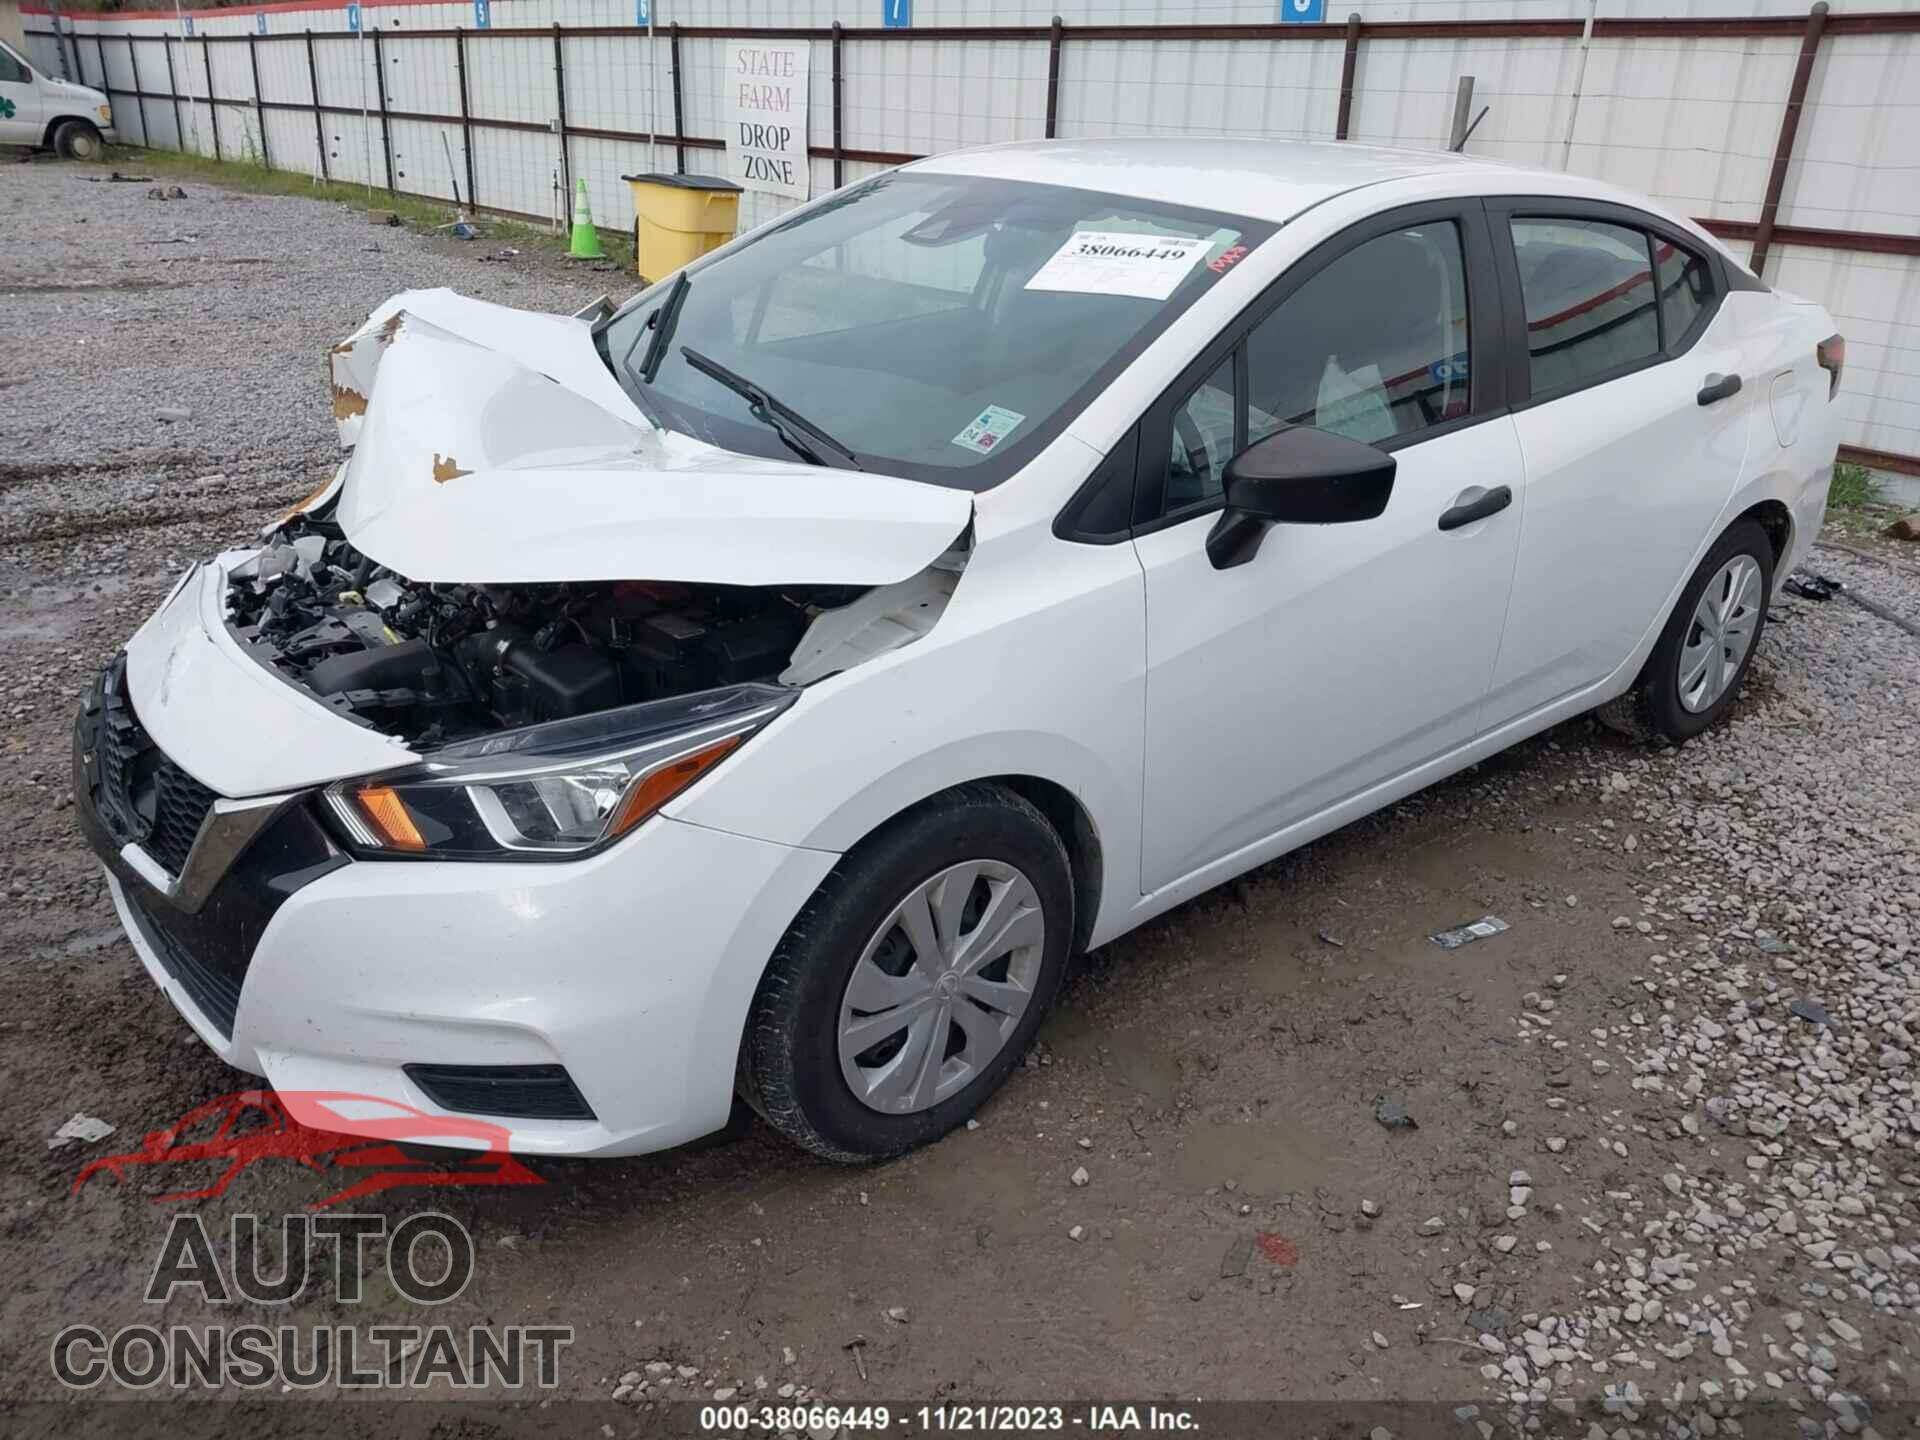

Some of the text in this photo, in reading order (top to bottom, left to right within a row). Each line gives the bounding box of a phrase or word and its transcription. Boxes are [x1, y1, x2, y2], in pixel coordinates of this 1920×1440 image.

[736, 48, 795, 78] STATE
[738, 83, 791, 112] FARM
[739, 122, 790, 151] DROP
[743, 154, 795, 185] ZONE
[1072, 243, 1186, 260] 38066449
